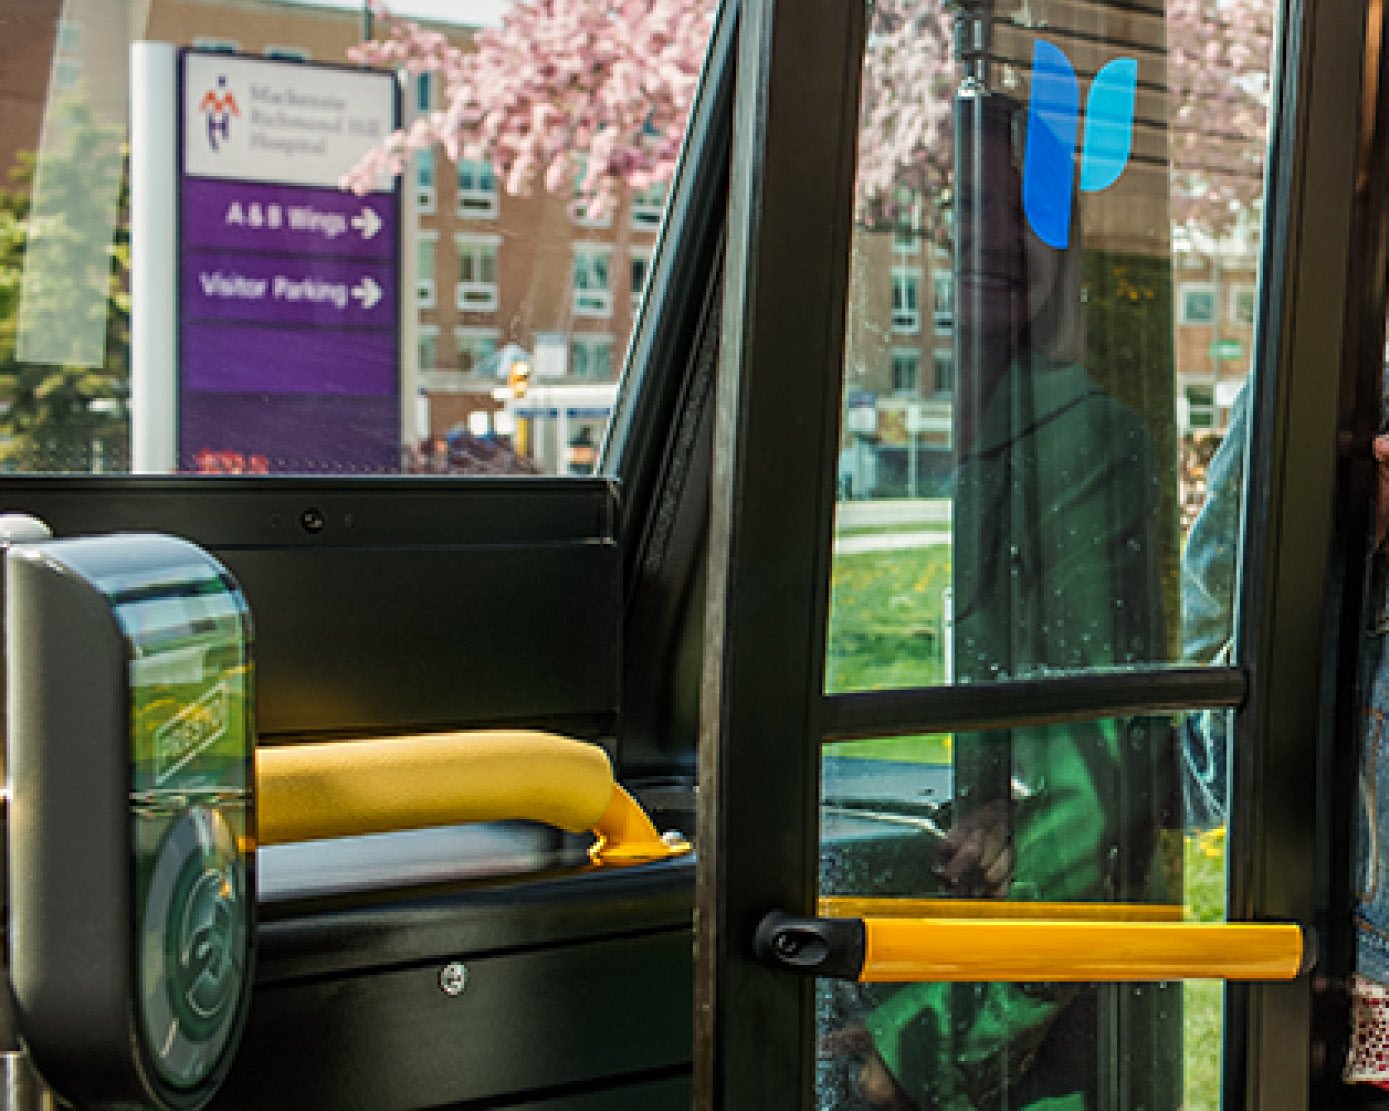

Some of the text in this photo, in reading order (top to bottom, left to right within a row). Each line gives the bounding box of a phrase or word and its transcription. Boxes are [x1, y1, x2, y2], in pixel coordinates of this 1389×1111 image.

[250, 132, 326, 157] Hospital
[226, 202, 347, 239] A & B Wings
[200, 271, 347, 309] Visitor Parking
